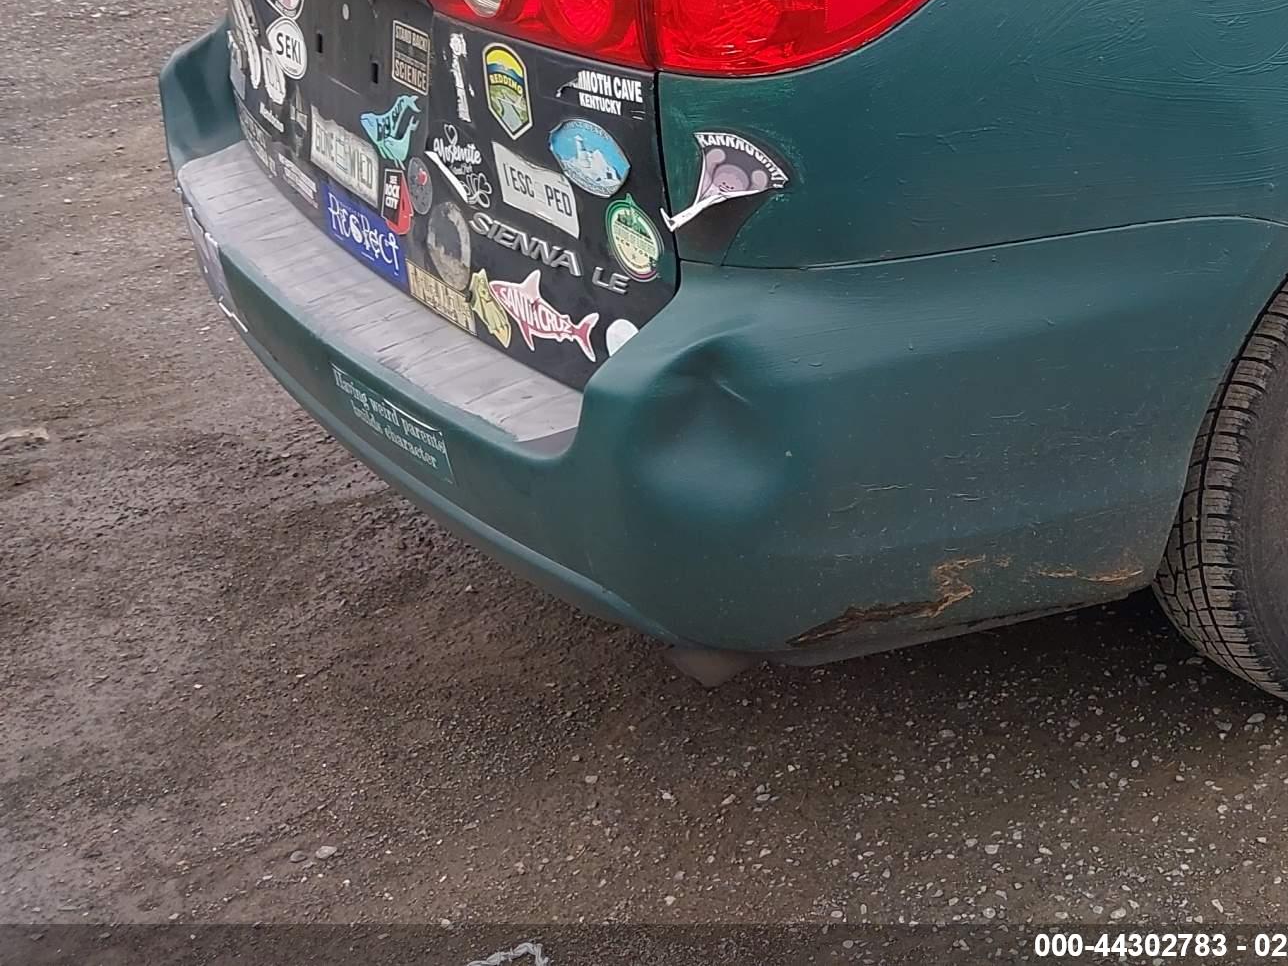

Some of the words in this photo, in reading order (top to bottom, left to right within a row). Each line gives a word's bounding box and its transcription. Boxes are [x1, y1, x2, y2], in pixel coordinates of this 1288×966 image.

[276, 32, 302, 65] SEKI
[395, 59, 427, 91] SCIENCE
[489, 72, 523, 96] REDDING
[613, 76, 644, 103] CAVE
[578, 91, 622, 116] KENTUCKY
[433, 136, 482, 164] Yosemite
[469, 211, 582, 278] SIENNA
[591, 266, 631, 295] LE
[499, 286, 541, 331] SANTA
[537, 302, 573, 333] CRUZ
[332, 367, 370, 412] Having
[368, 397, 400, 428] weird
[400, 417, 446, 455] parents
[384, 424, 439, 470] character
